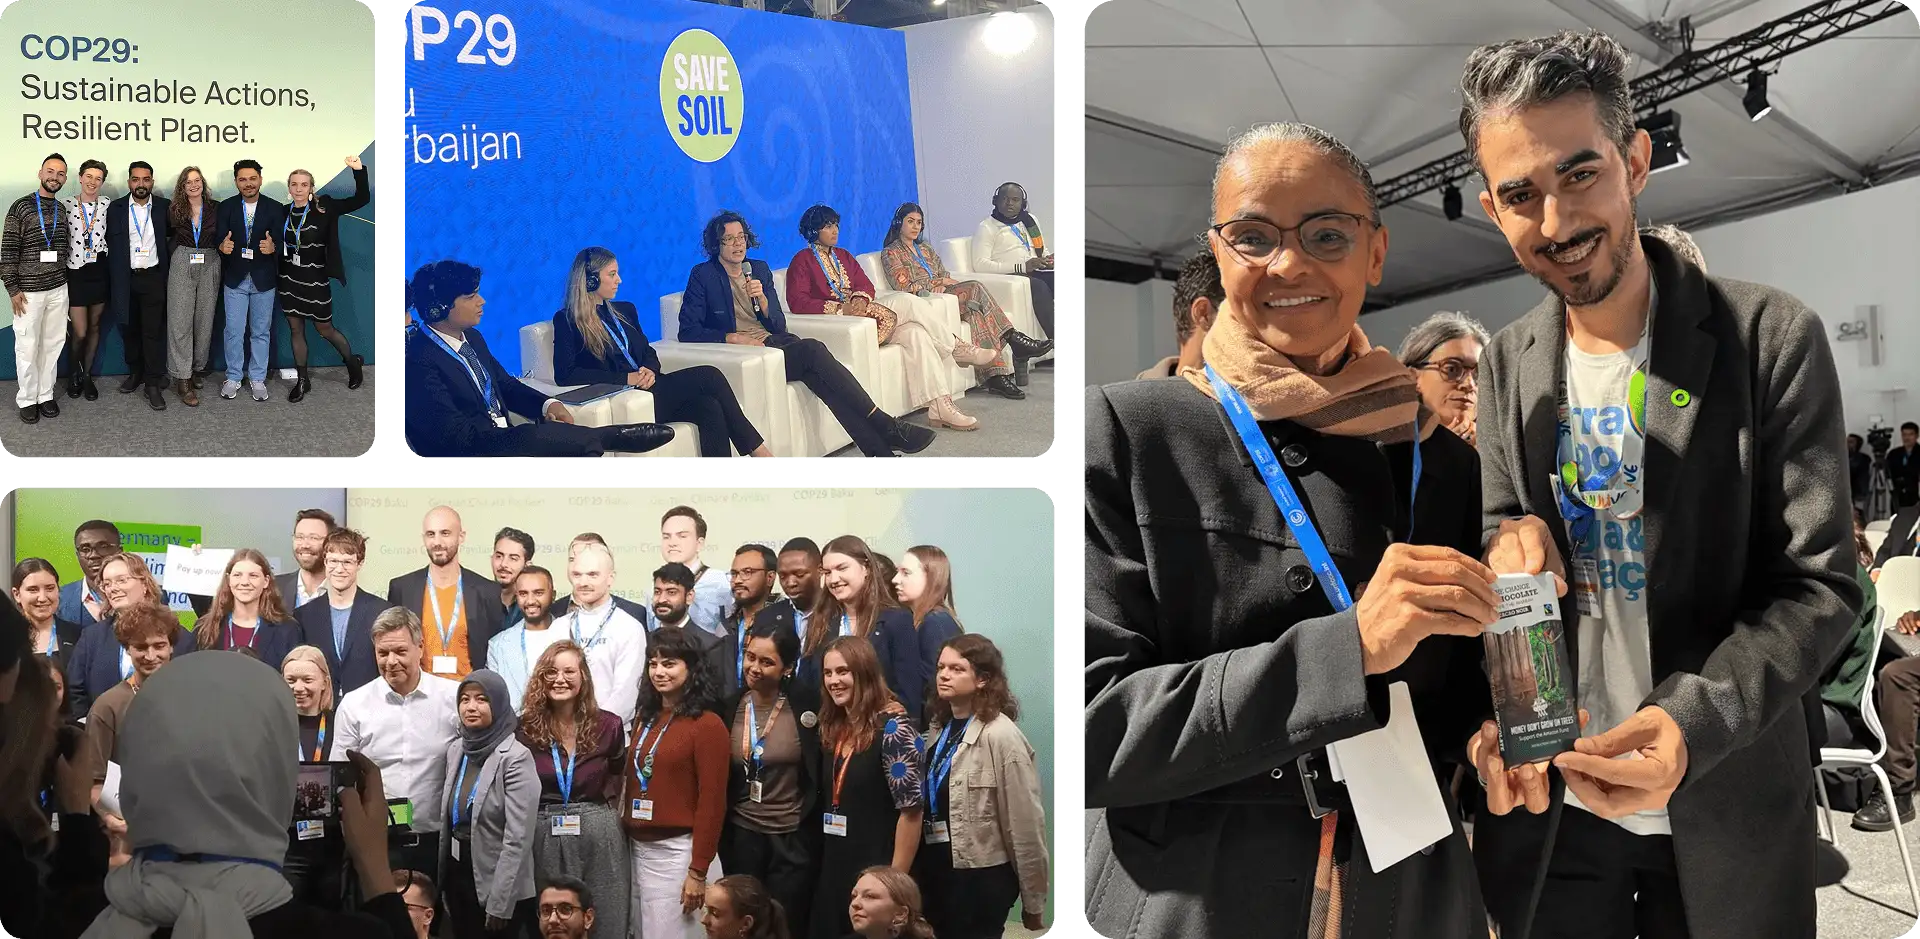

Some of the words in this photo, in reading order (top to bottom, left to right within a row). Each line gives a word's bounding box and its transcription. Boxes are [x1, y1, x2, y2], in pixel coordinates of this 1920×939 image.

[20, 34, 139, 63] COP29:
[404, 5, 517, 66] P29
[673, 53, 730, 92] SAVE
[20, 73, 197, 104] Sustainable
[204, 80, 316, 111] Actions,
[22, 113, 152, 141] Resilient
[161, 118, 255, 143] Planet.
[677, 94, 733, 137] SOIL
[405, 124, 521, 169] baijan
[119, 532, 181, 546] ermany
[1500, 589, 1539, 603] HOCOLATE
[1510, 724, 1527, 735] MONEY
[1561, 716, 1574, 726] TREES
